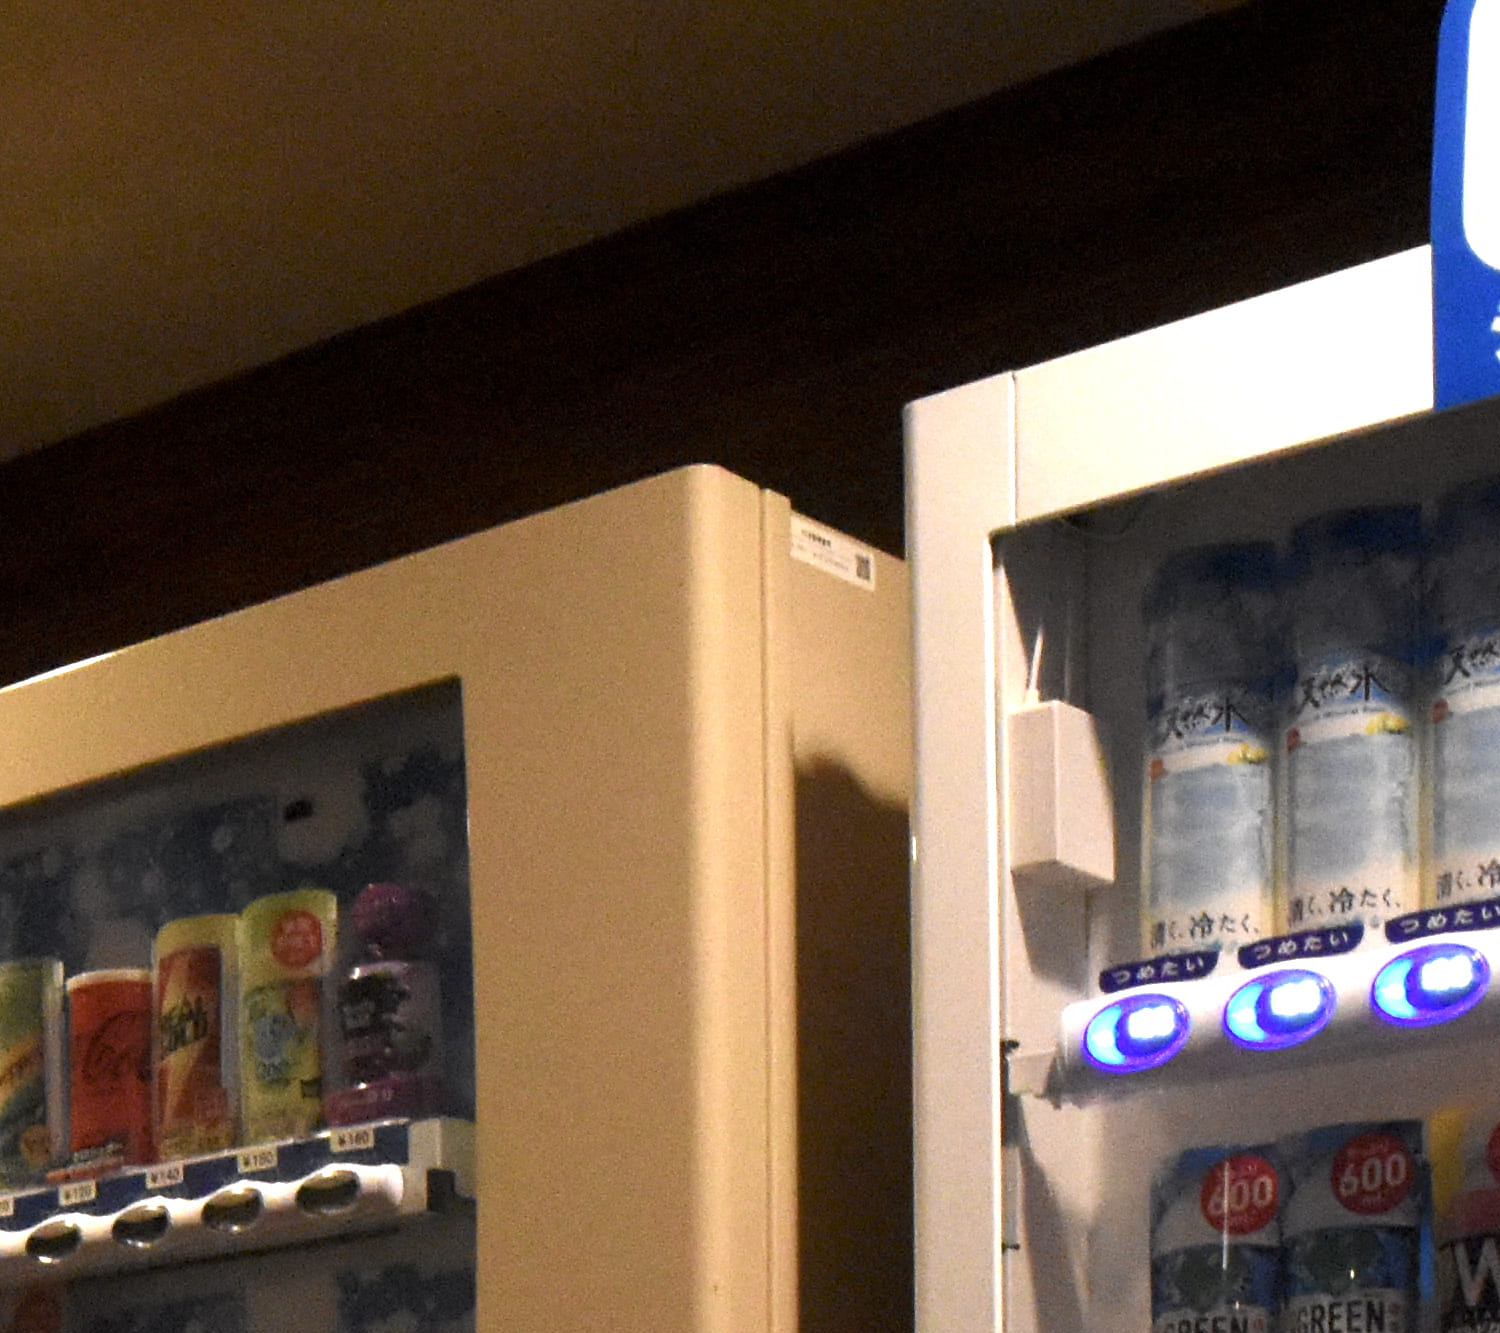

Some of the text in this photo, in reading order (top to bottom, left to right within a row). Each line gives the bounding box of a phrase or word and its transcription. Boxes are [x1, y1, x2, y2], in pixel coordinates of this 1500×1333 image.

[1298, 661, 1386, 711] 天然水
[1166, 695, 1250, 740] 天然水
[1251, 932, 1350, 960] つめたい
[1111, 955, 1204, 984] つめたい
[1206, 1175, 1273, 1212] 600
[1339, 1154, 1407, 1195] 600
